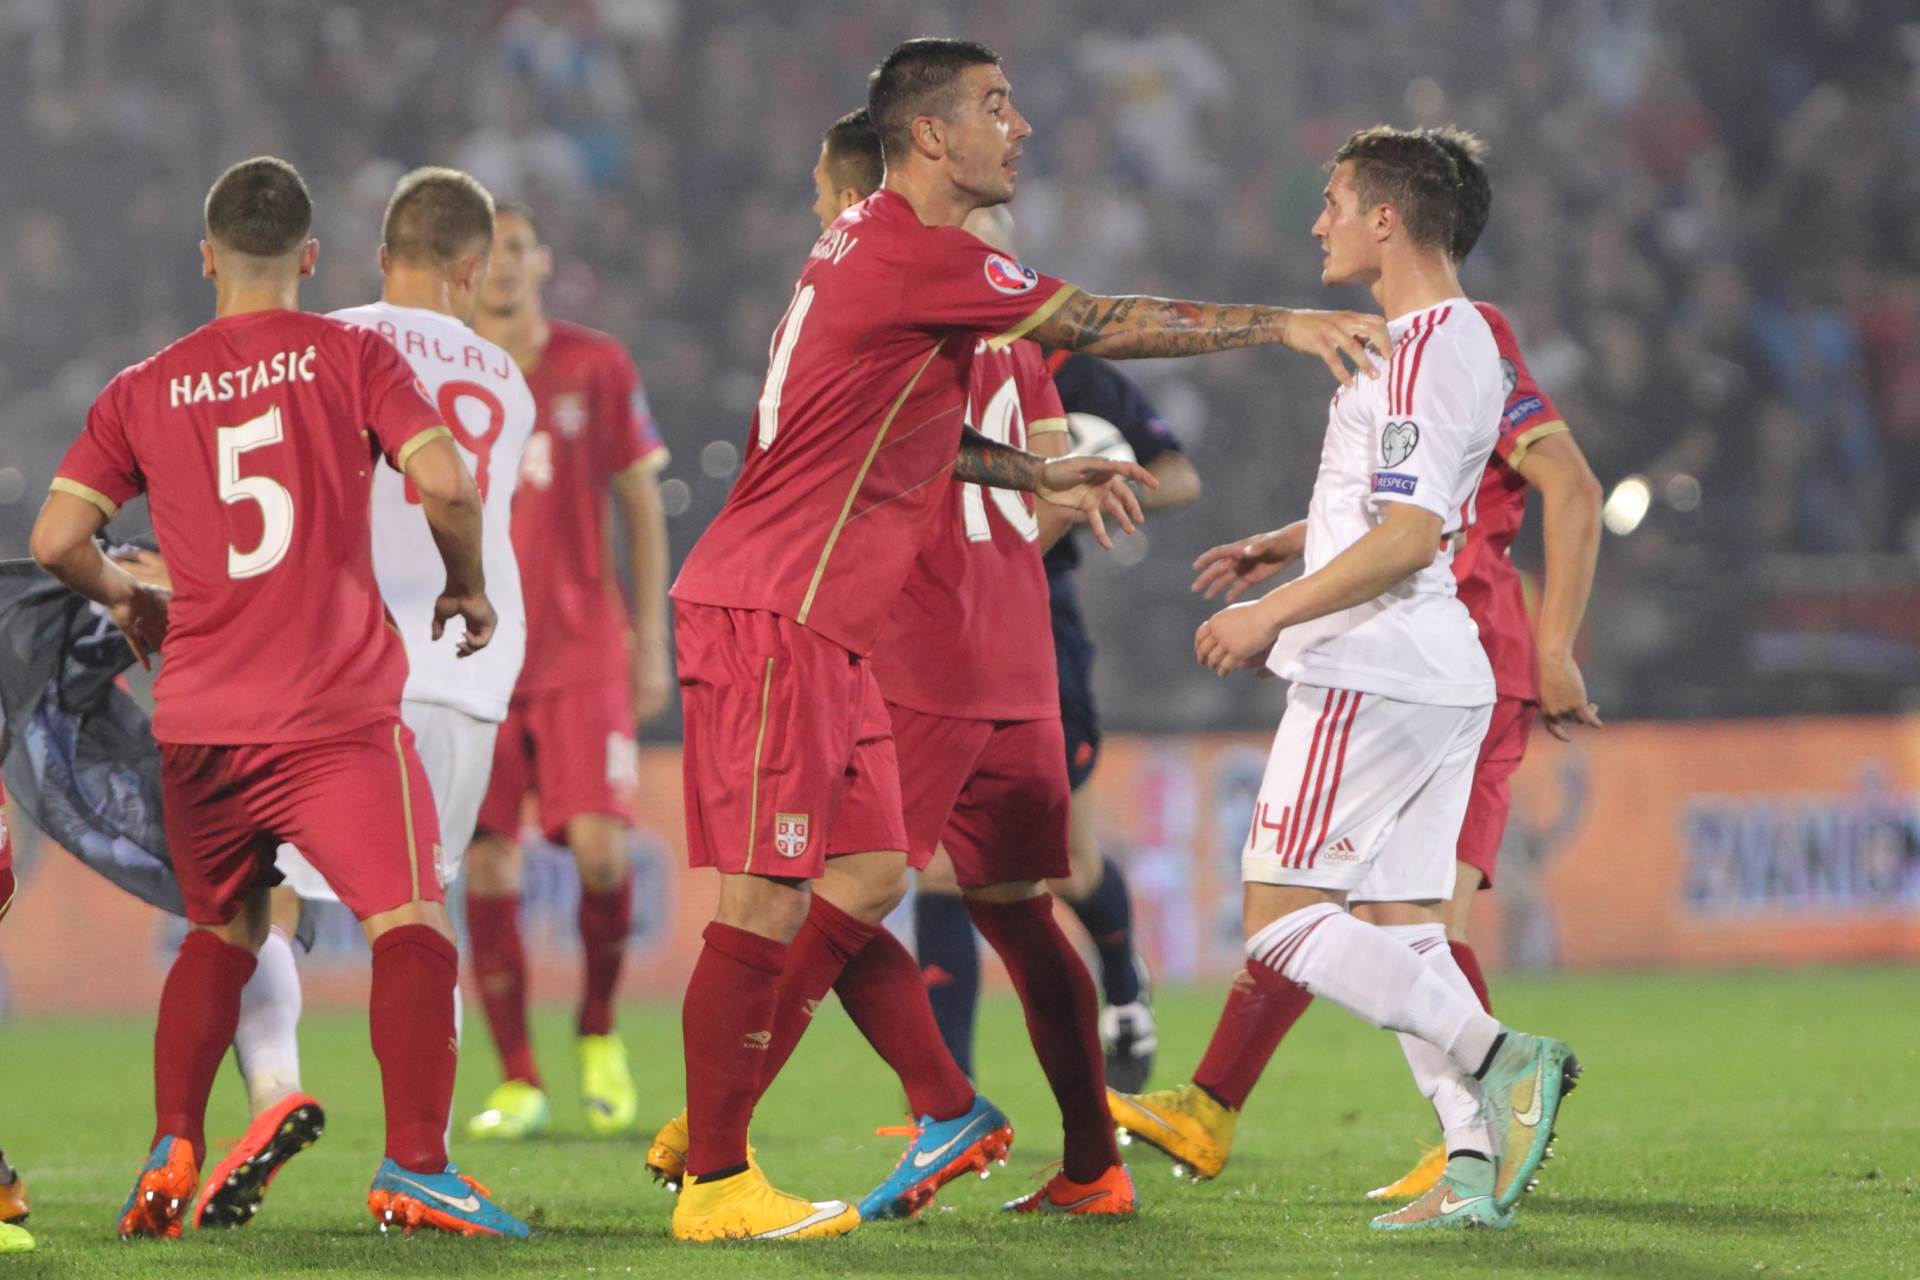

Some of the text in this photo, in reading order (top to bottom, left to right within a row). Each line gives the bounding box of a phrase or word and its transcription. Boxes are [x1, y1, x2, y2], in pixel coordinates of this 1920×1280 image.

[170, 345, 317, 407] HASTASIĆ
[404, 378, 506, 508] 9
[217, 404, 295, 580] 5
[1377, 477, 1415, 491] RESPECT
[1250, 801, 1291, 855] 14
[1324, 849, 1361, 863] adidas
